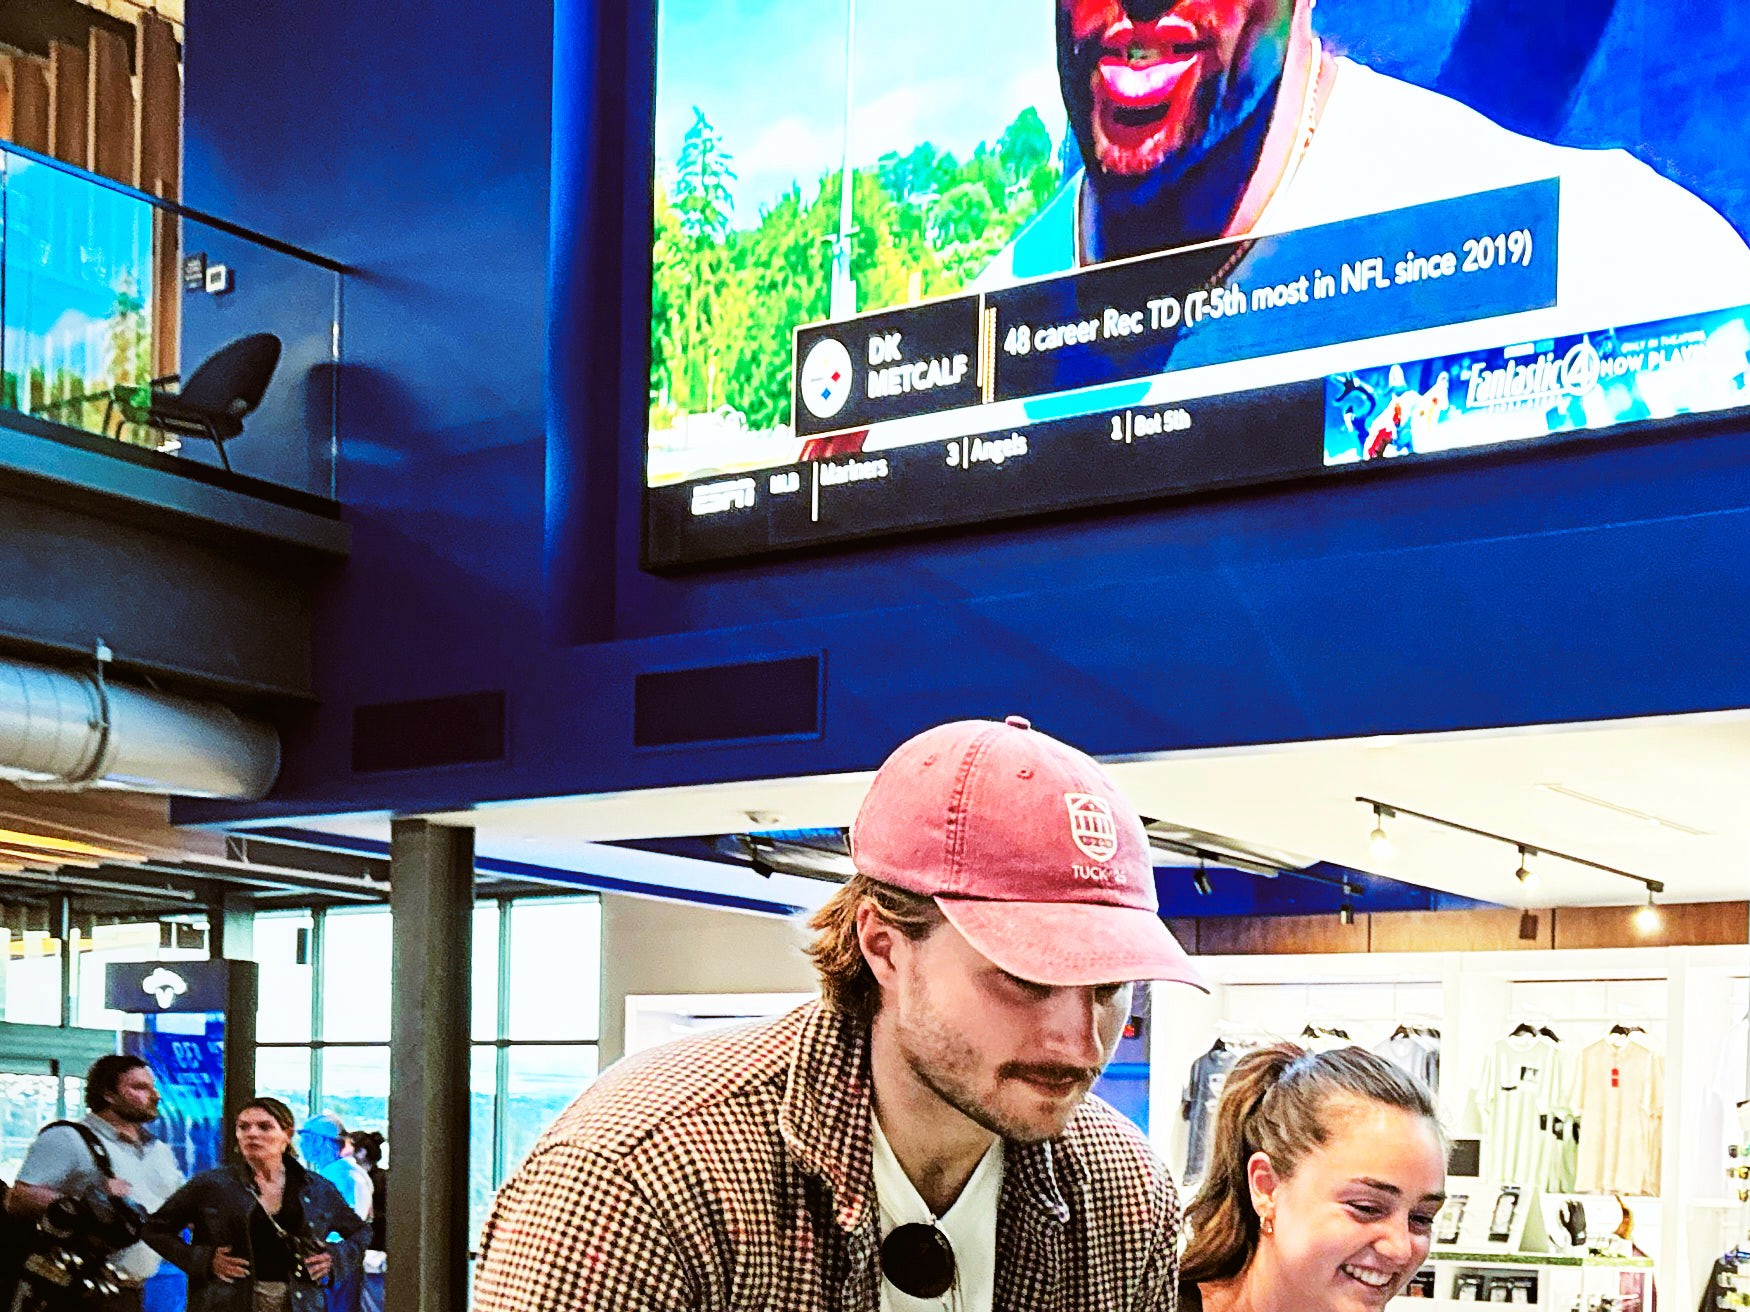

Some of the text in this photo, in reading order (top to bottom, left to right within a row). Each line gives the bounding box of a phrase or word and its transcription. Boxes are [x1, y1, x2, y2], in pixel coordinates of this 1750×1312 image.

[1004, 228, 1533, 356] 48 career Rec TD (T-5th most in NFL since 2019)
[868, 332, 902, 365] DK
[1600, 353, 1644, 378] NOW
[867, 354, 968, 399] METCALF
[1465, 352, 1566, 408] Fantastic
[820, 458, 889, 486] Mariners
[946, 442, 960, 467] 3
[970, 431, 1028, 464] Angels
[1111, 415, 1123, 441] 1
[1134, 412, 1162, 437] Bot
[691, 478, 756, 515] ESPN
[1071, 864, 1108, 881] TUCK
